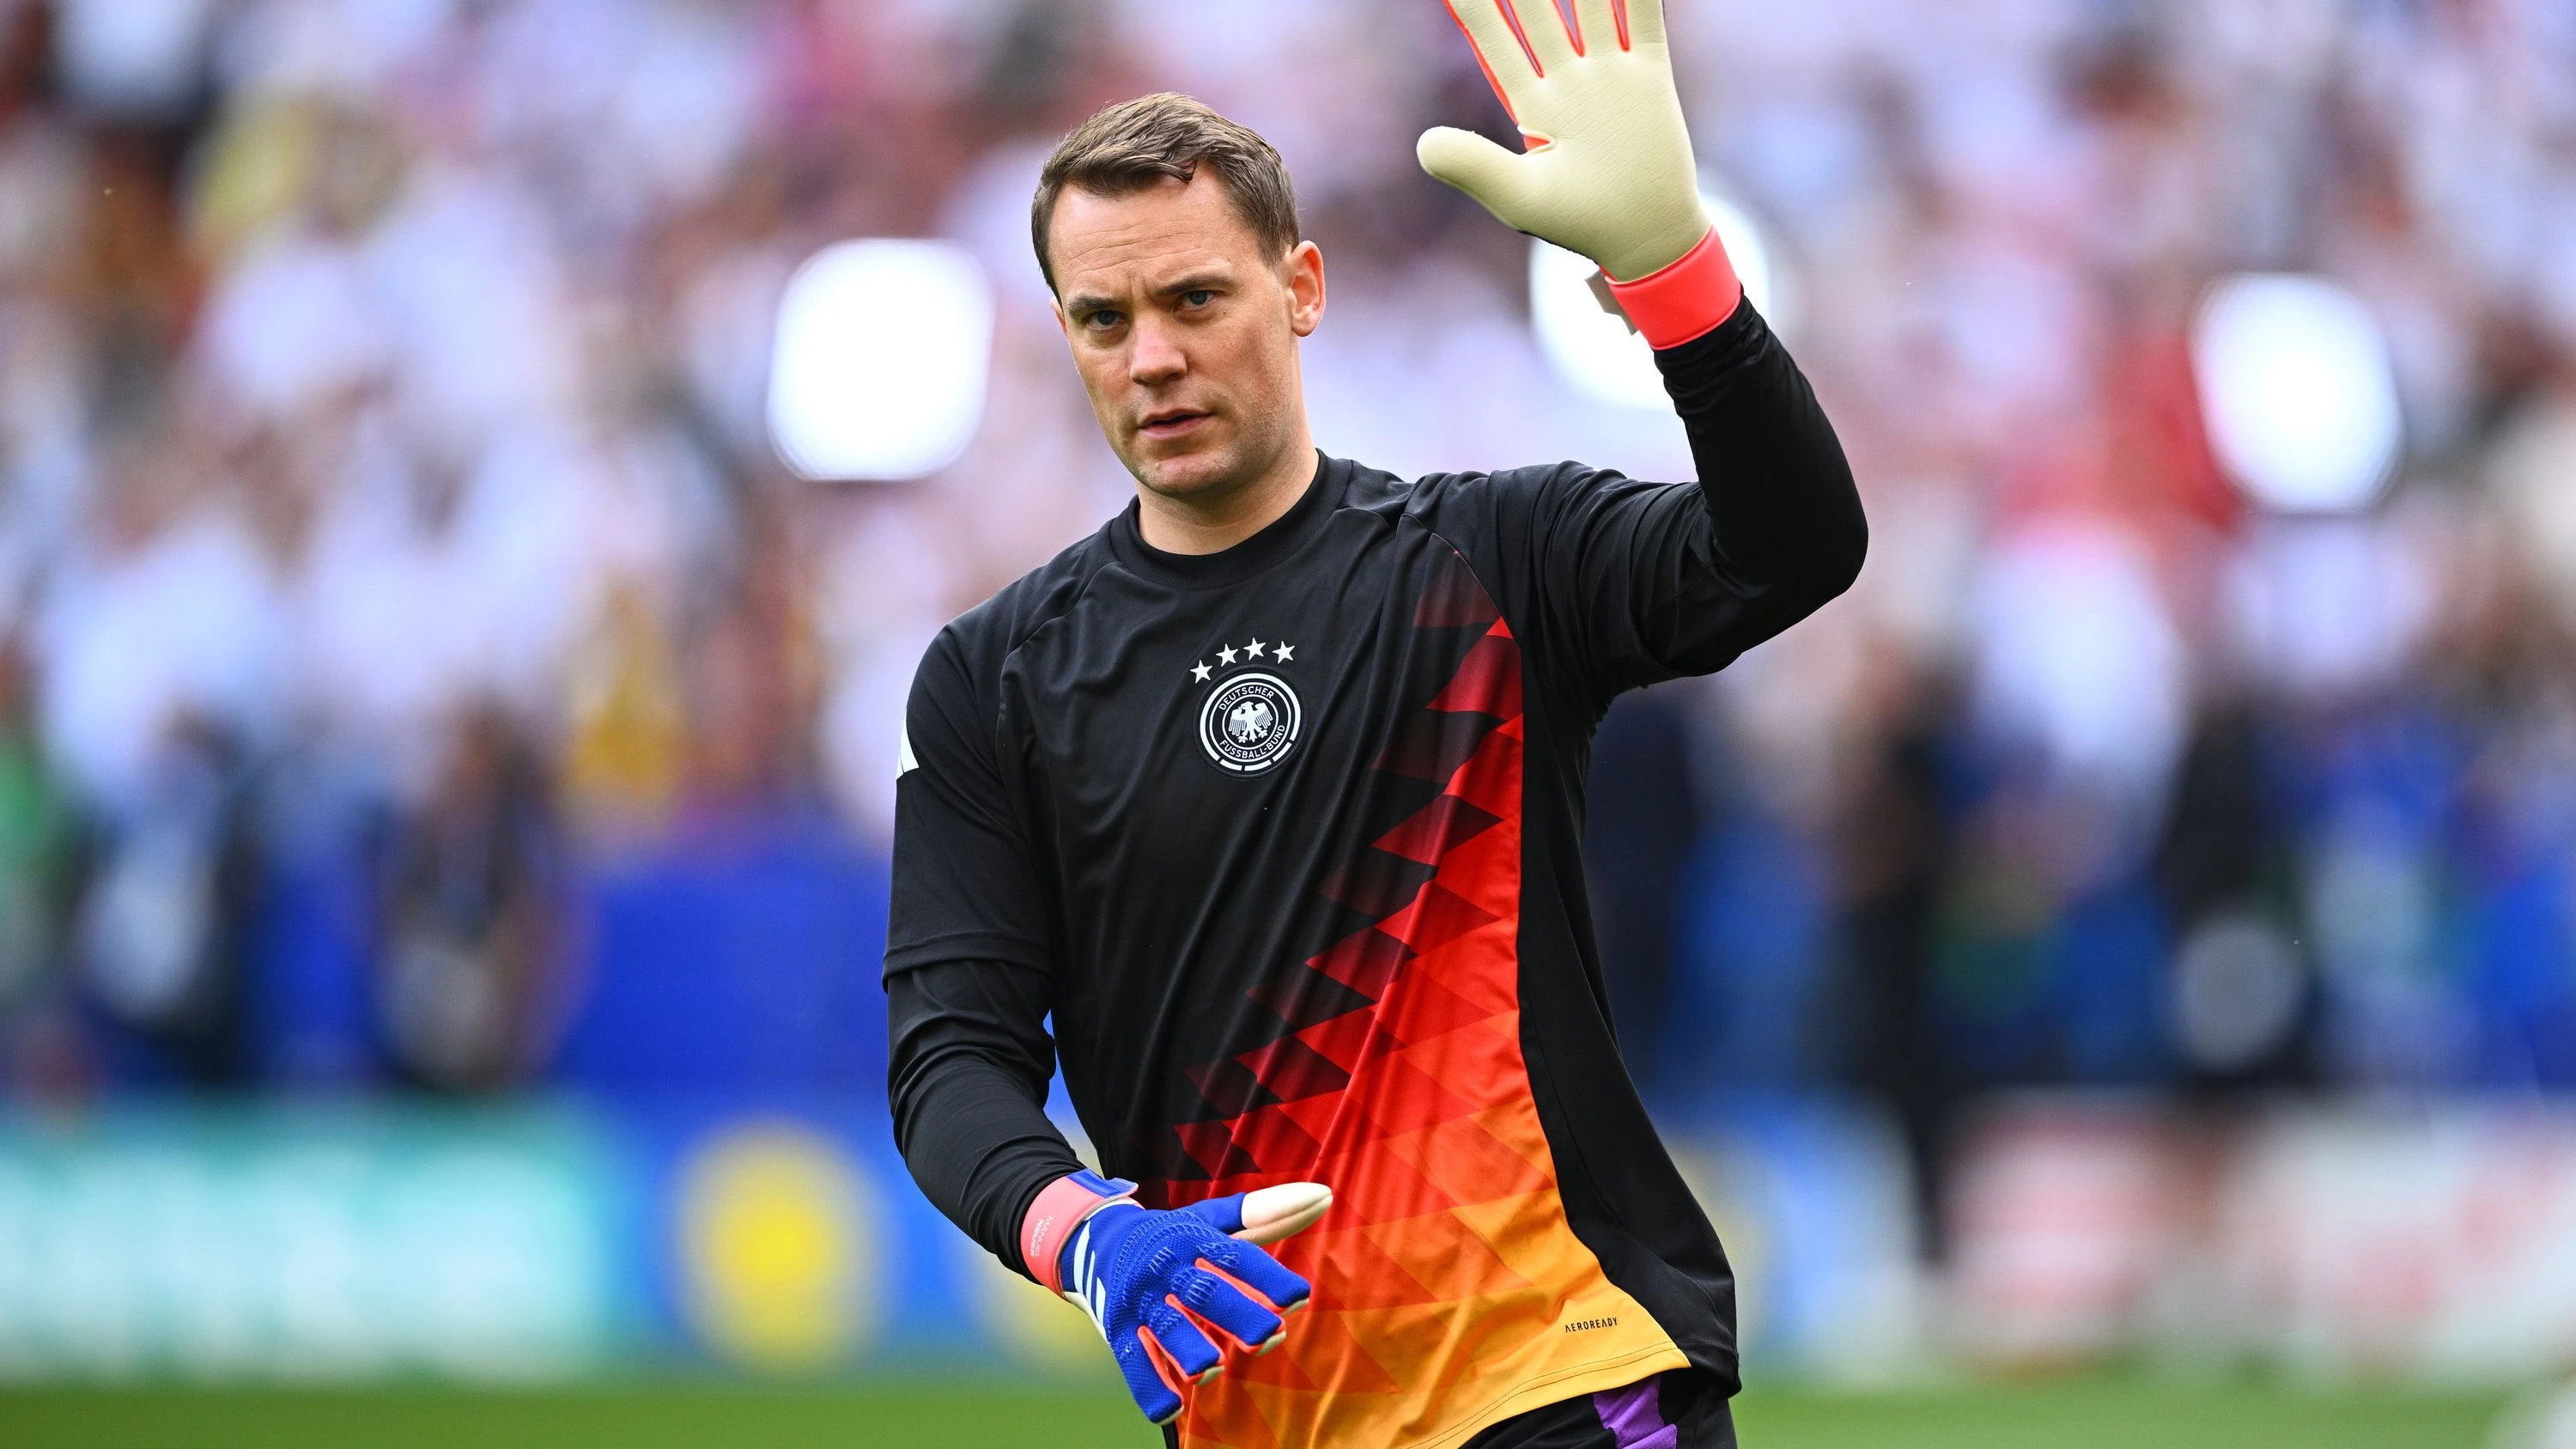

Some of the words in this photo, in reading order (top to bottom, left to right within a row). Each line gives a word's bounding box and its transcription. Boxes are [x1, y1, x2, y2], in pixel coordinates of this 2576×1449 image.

[1218, 685, 1274, 711] DEUTSCHER
[1219, 725, 1285, 758] FUSSBALL-BUND
[1030, 1219, 1044, 1257] NEUER
[1033, 1215, 1054, 1258] MANUEL
[1565, 1317, 1618, 1332] AEROREADY
